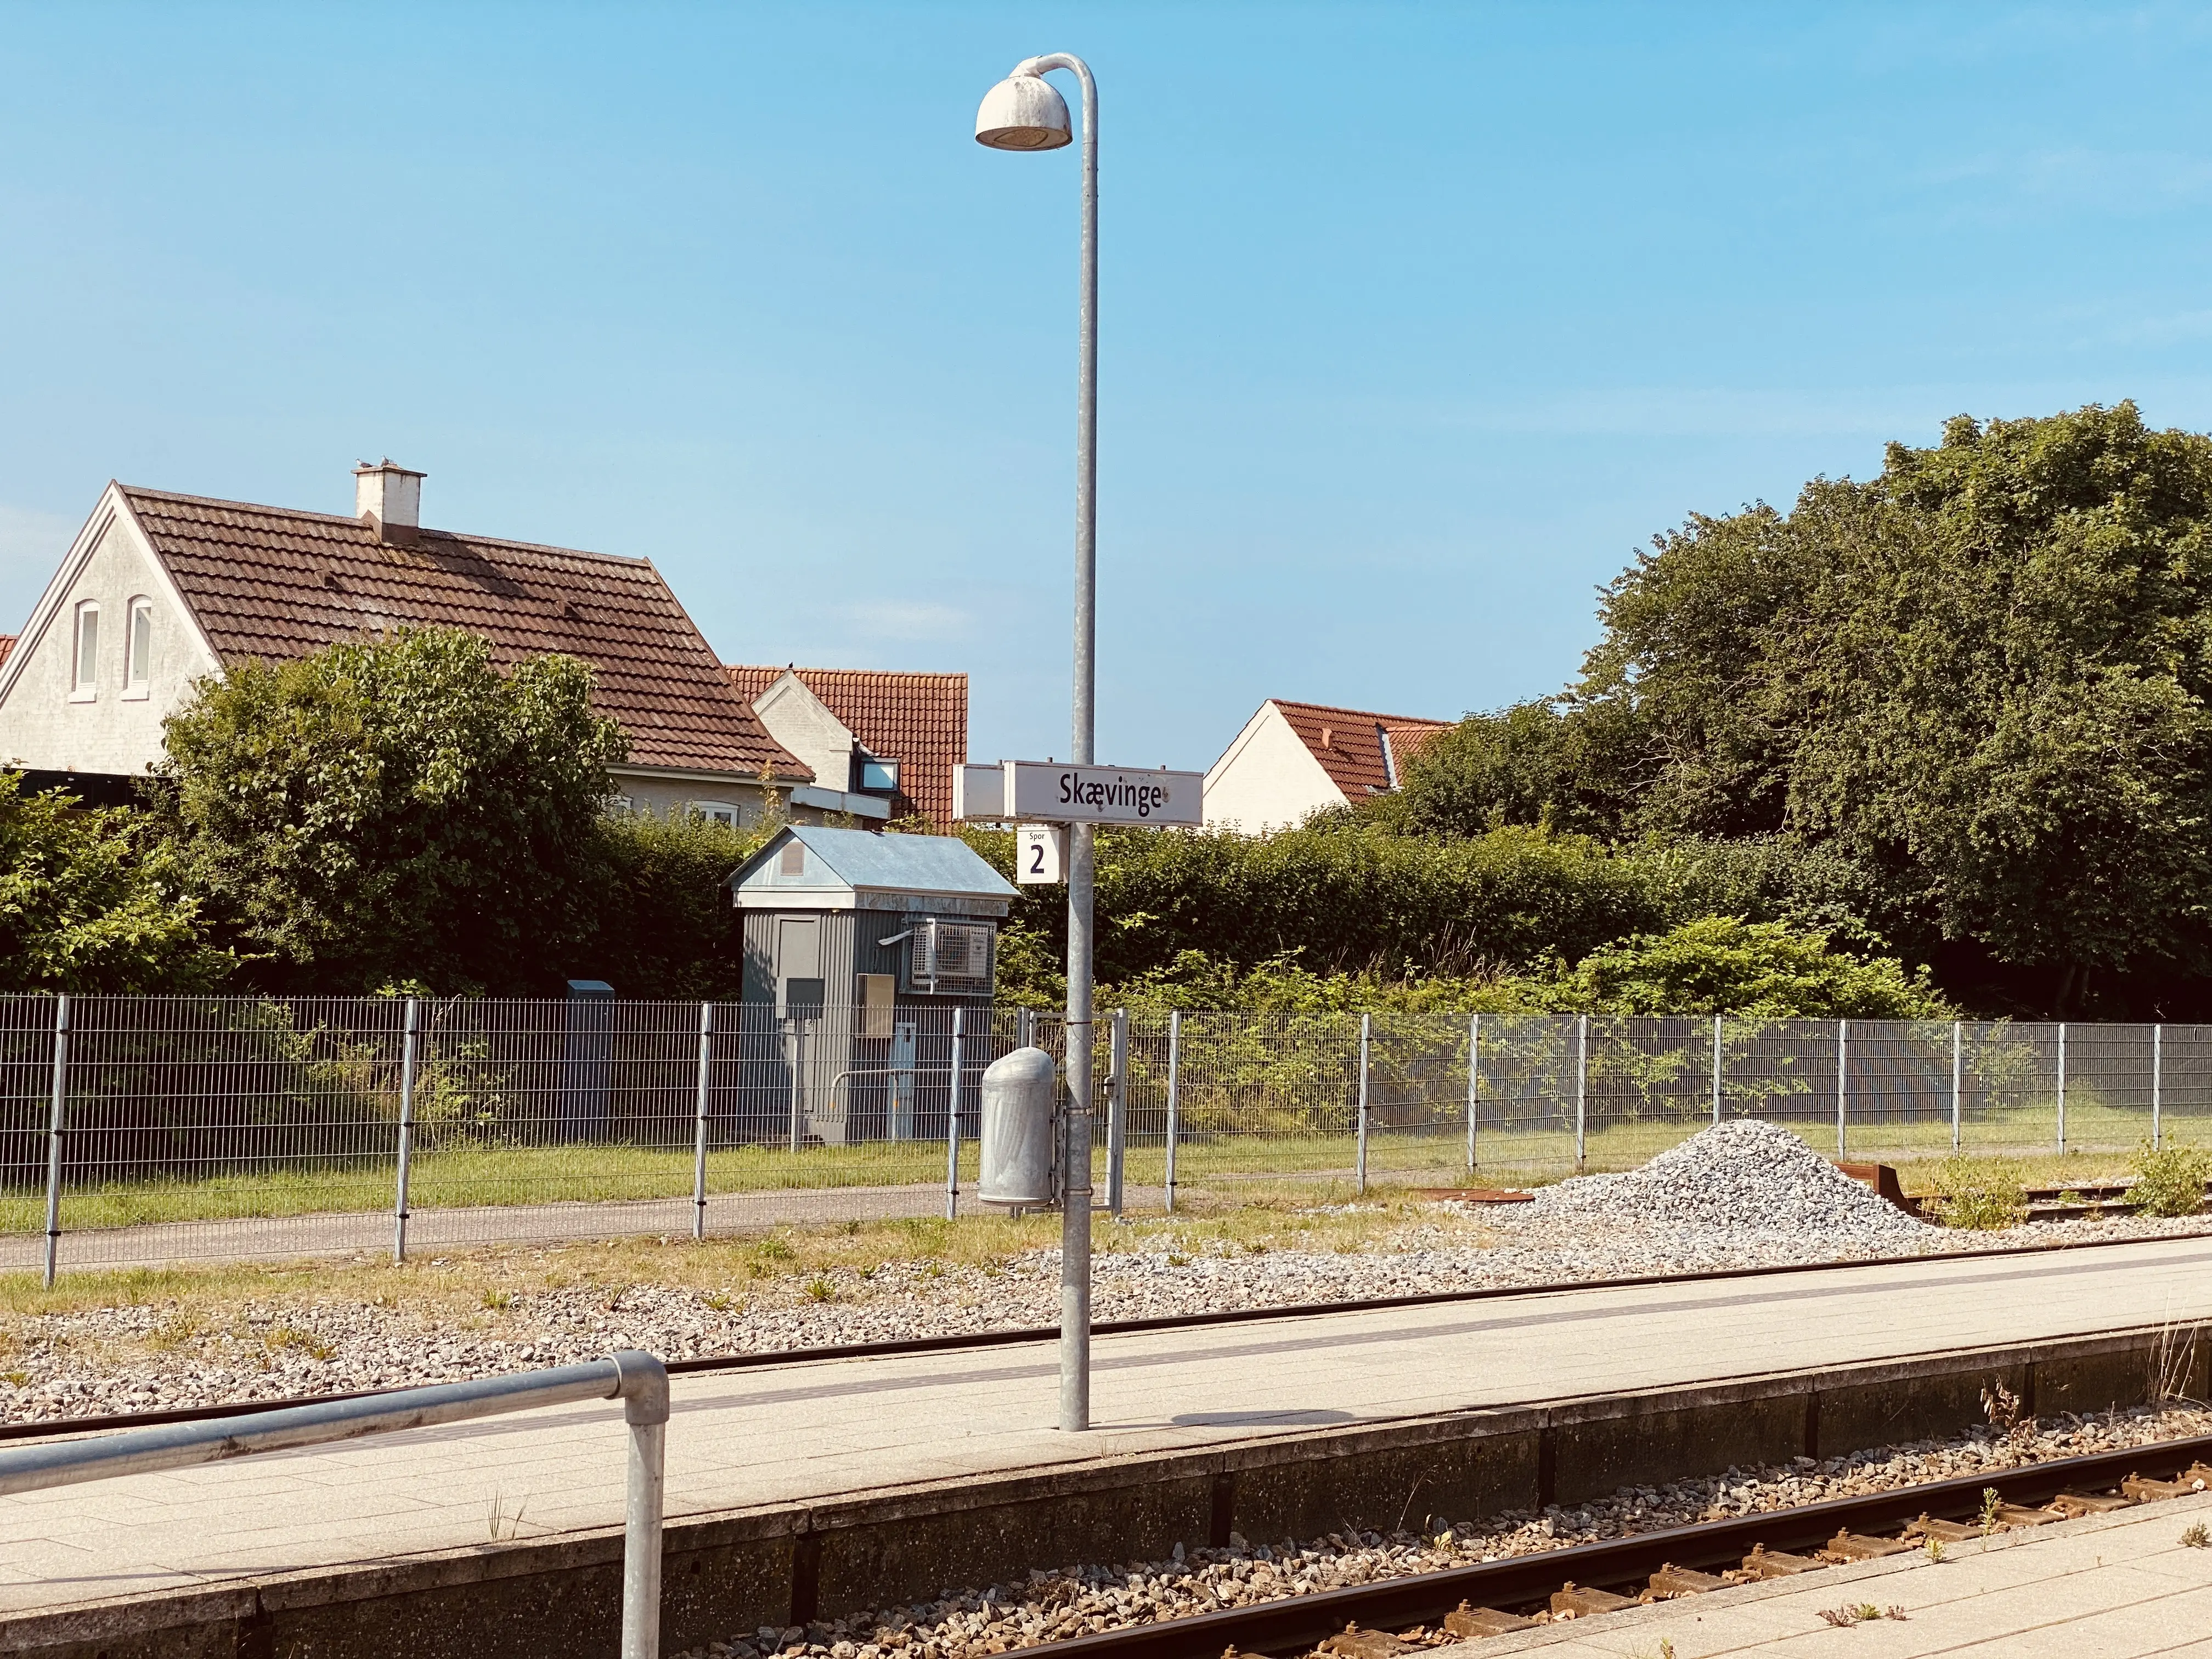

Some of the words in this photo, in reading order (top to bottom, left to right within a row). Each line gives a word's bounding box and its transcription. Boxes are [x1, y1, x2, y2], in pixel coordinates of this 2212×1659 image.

[1060, 772, 1161, 817] Skævinge
[1029, 832, 1045, 842] Spor
[1030, 844, 1045, 874] 2
